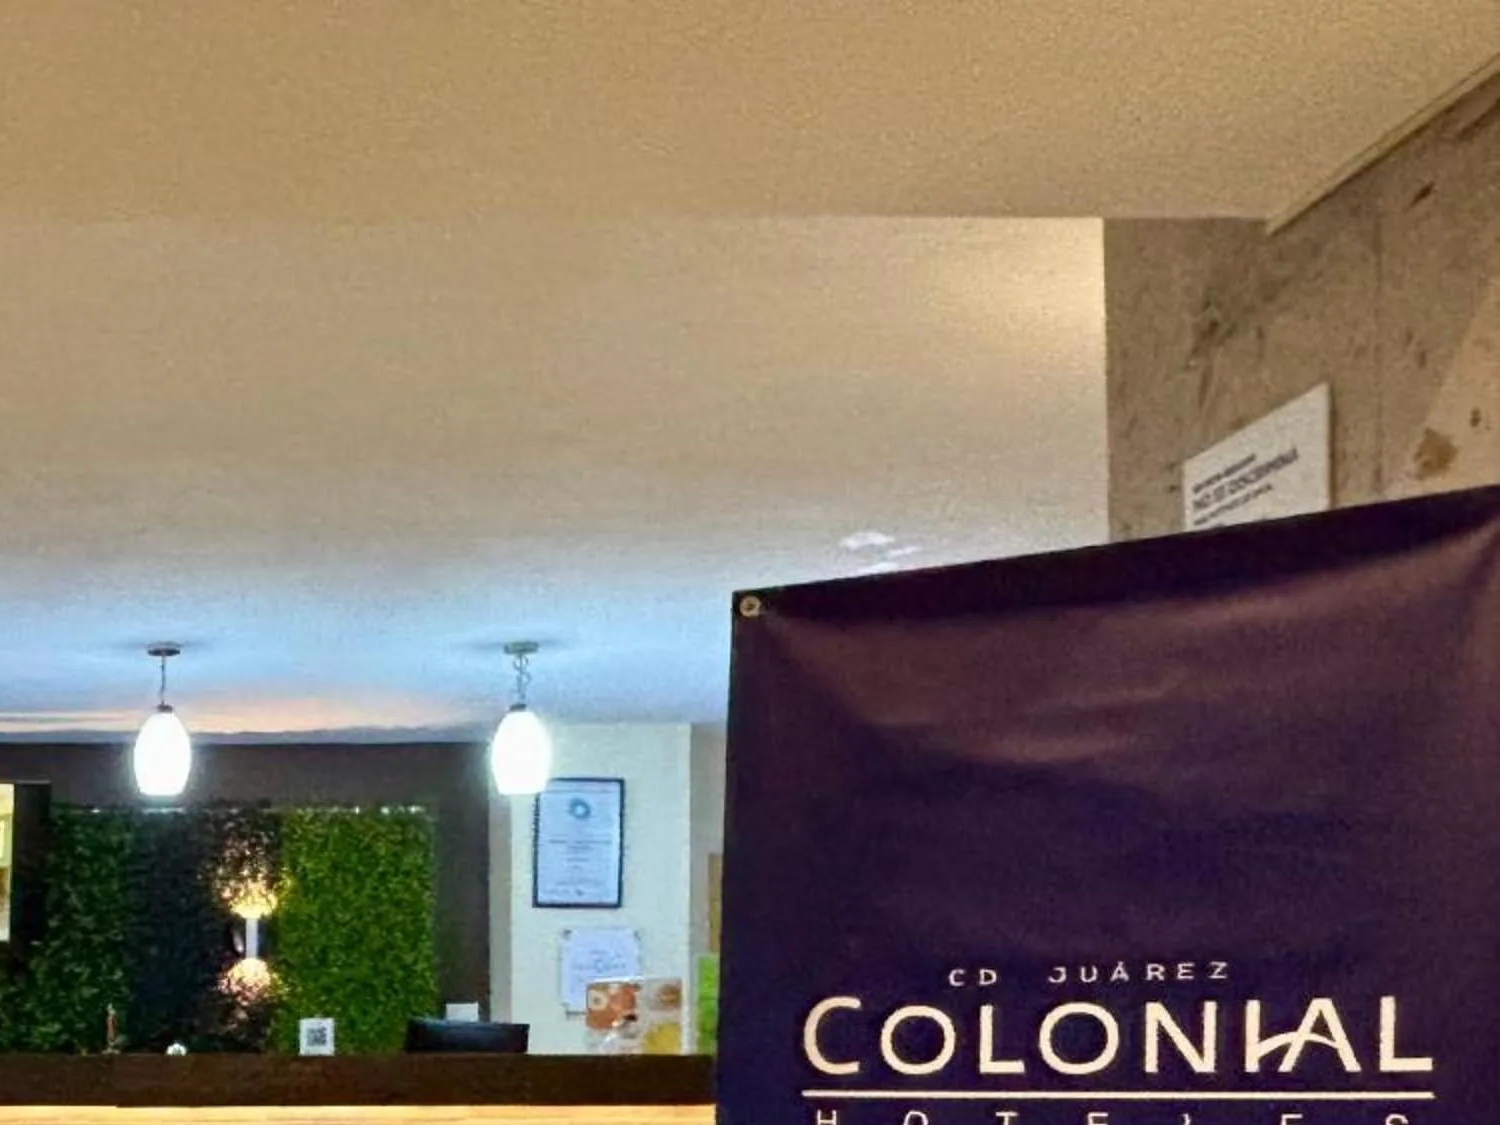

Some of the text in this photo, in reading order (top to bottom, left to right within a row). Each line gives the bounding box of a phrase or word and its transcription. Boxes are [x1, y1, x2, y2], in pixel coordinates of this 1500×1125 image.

[947, 960, 1229, 987] CD JUÁREZ
[802, 995, 1435, 1076] COLONIAL
